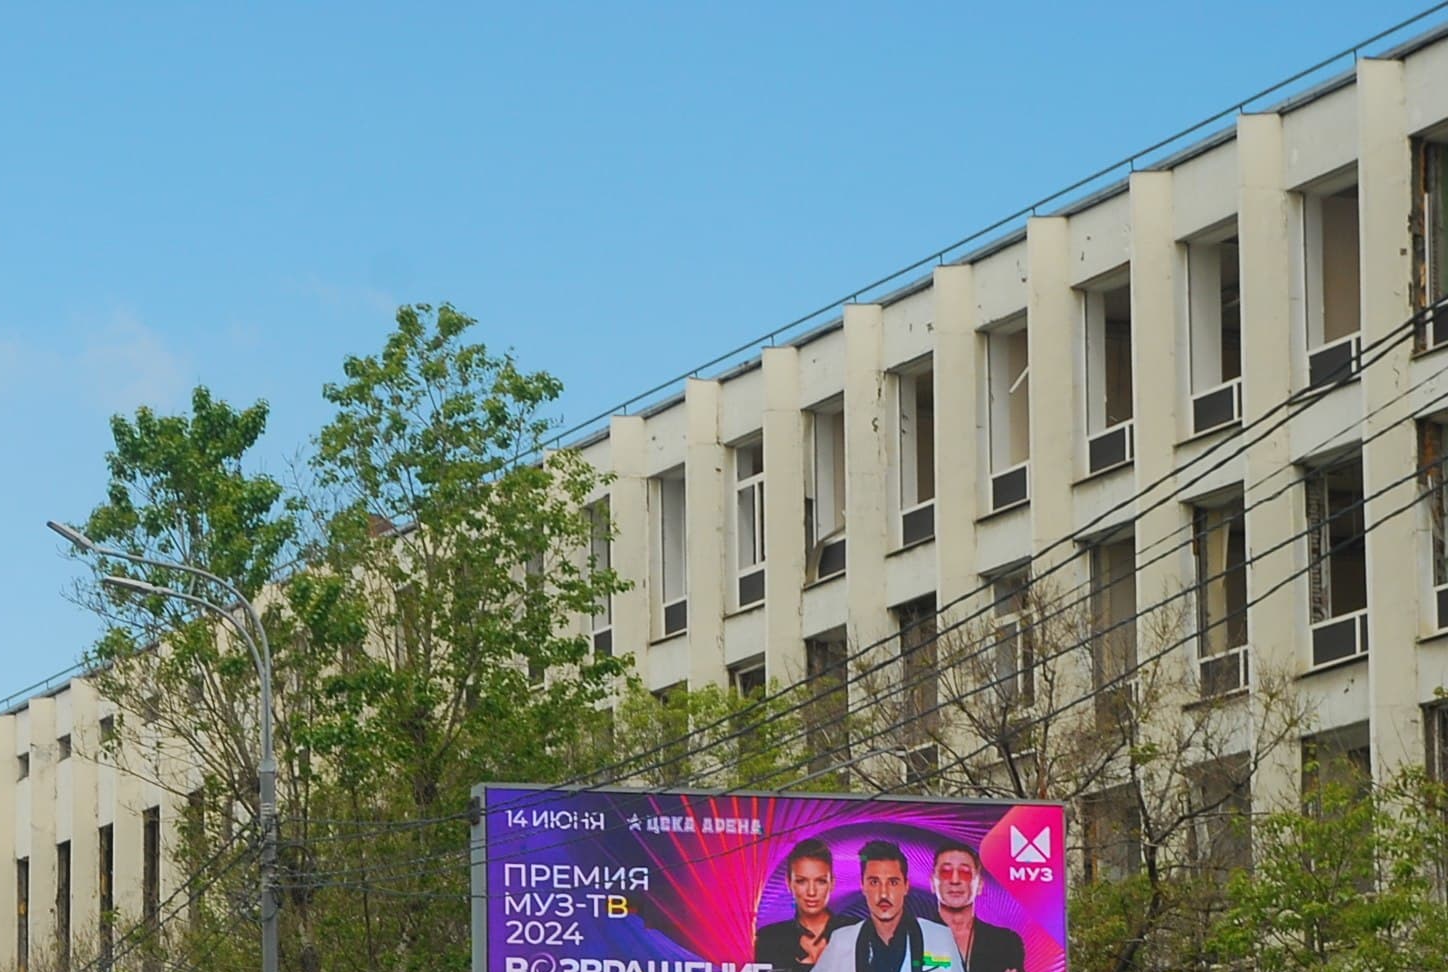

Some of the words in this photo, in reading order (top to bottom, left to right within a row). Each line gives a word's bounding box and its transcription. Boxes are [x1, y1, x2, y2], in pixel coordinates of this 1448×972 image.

[505, 810, 528, 828] 14
[532, 810, 605, 830] ИЮНЯ
[646, 815, 696, 834] ЦСКА
[702, 817, 763, 835] АРЕНА
[504, 863, 649, 891] ПРЕМИЯ
[1009, 866, 1053, 882] МУЗ
[504, 892, 629, 918] МУЗ-ТВ
[505, 920, 584, 945] 2024
